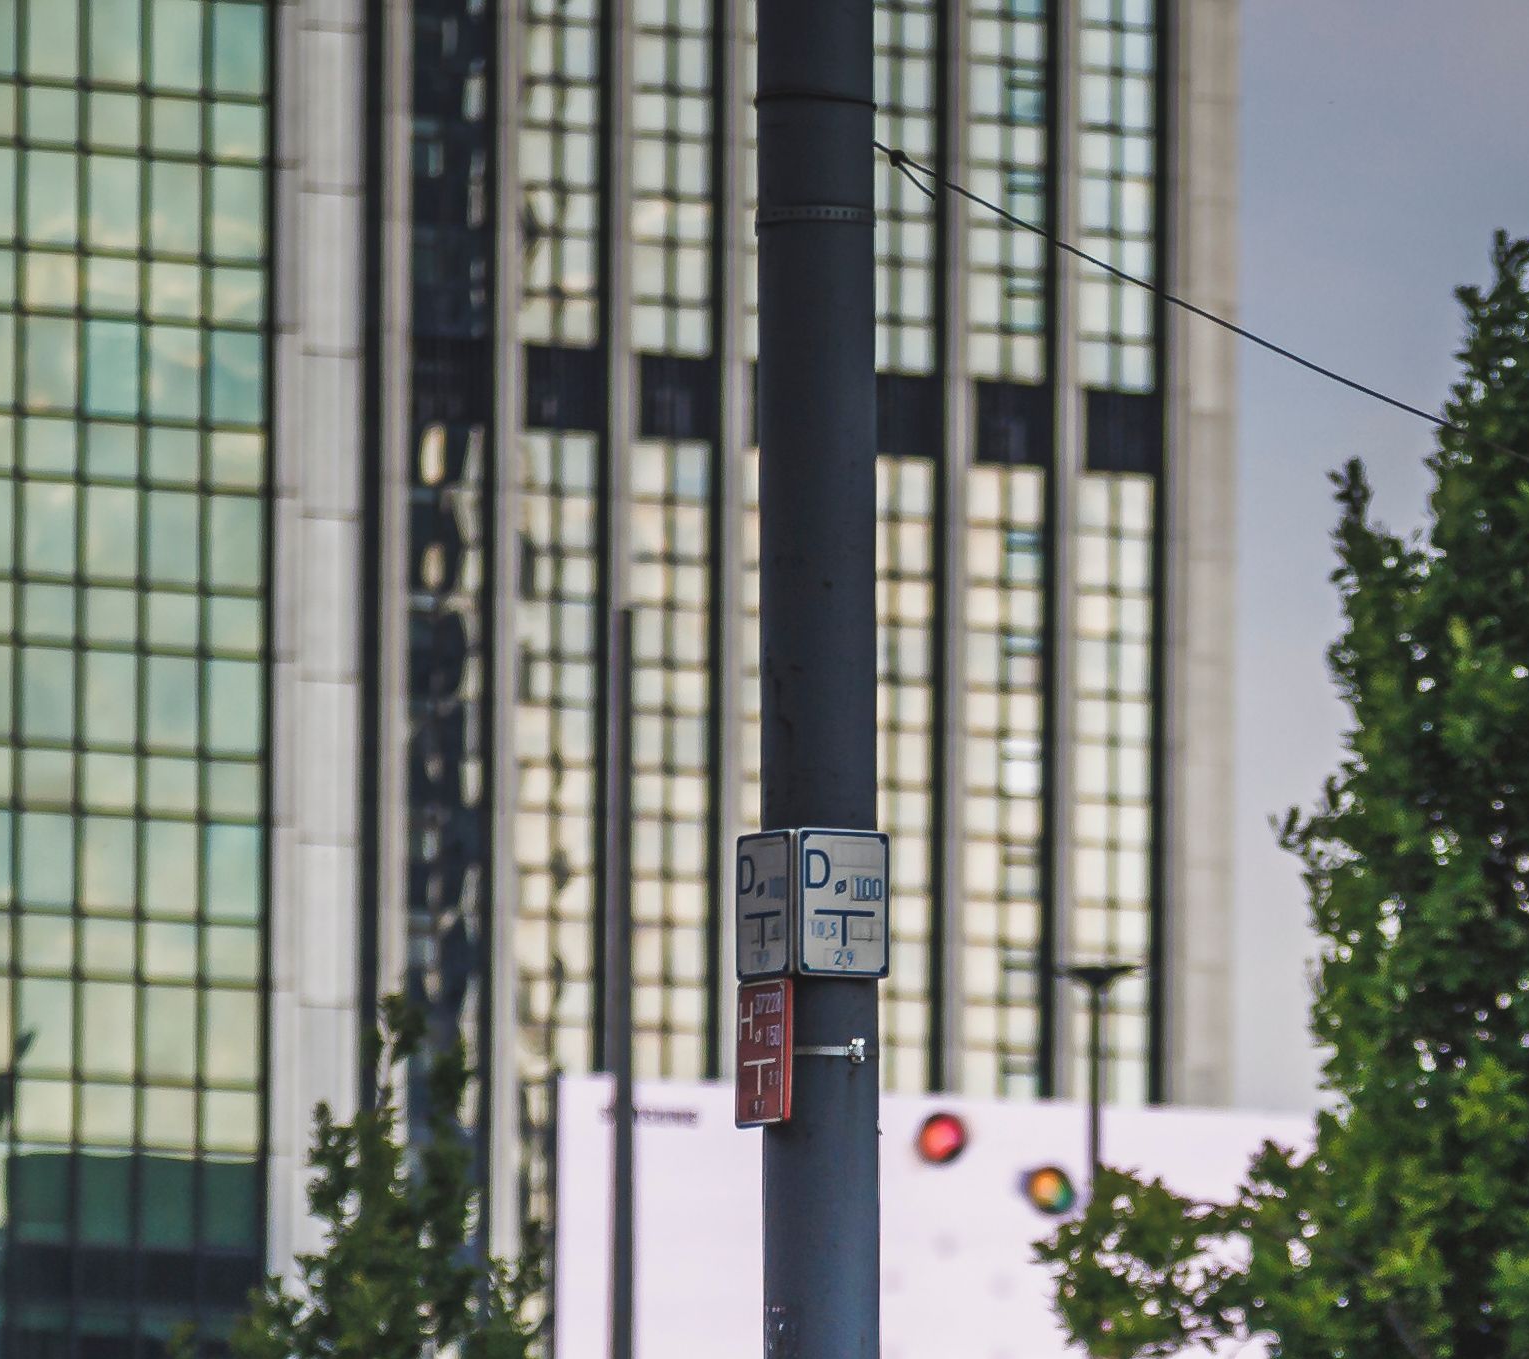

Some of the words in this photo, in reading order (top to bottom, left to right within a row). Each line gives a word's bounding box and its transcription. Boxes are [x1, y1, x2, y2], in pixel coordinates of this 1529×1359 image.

[736, 856, 755, 895] D
[805, 849, 831, 889] D
[855, 877, 883, 900] 100
[738, 1001, 753, 1041] H
